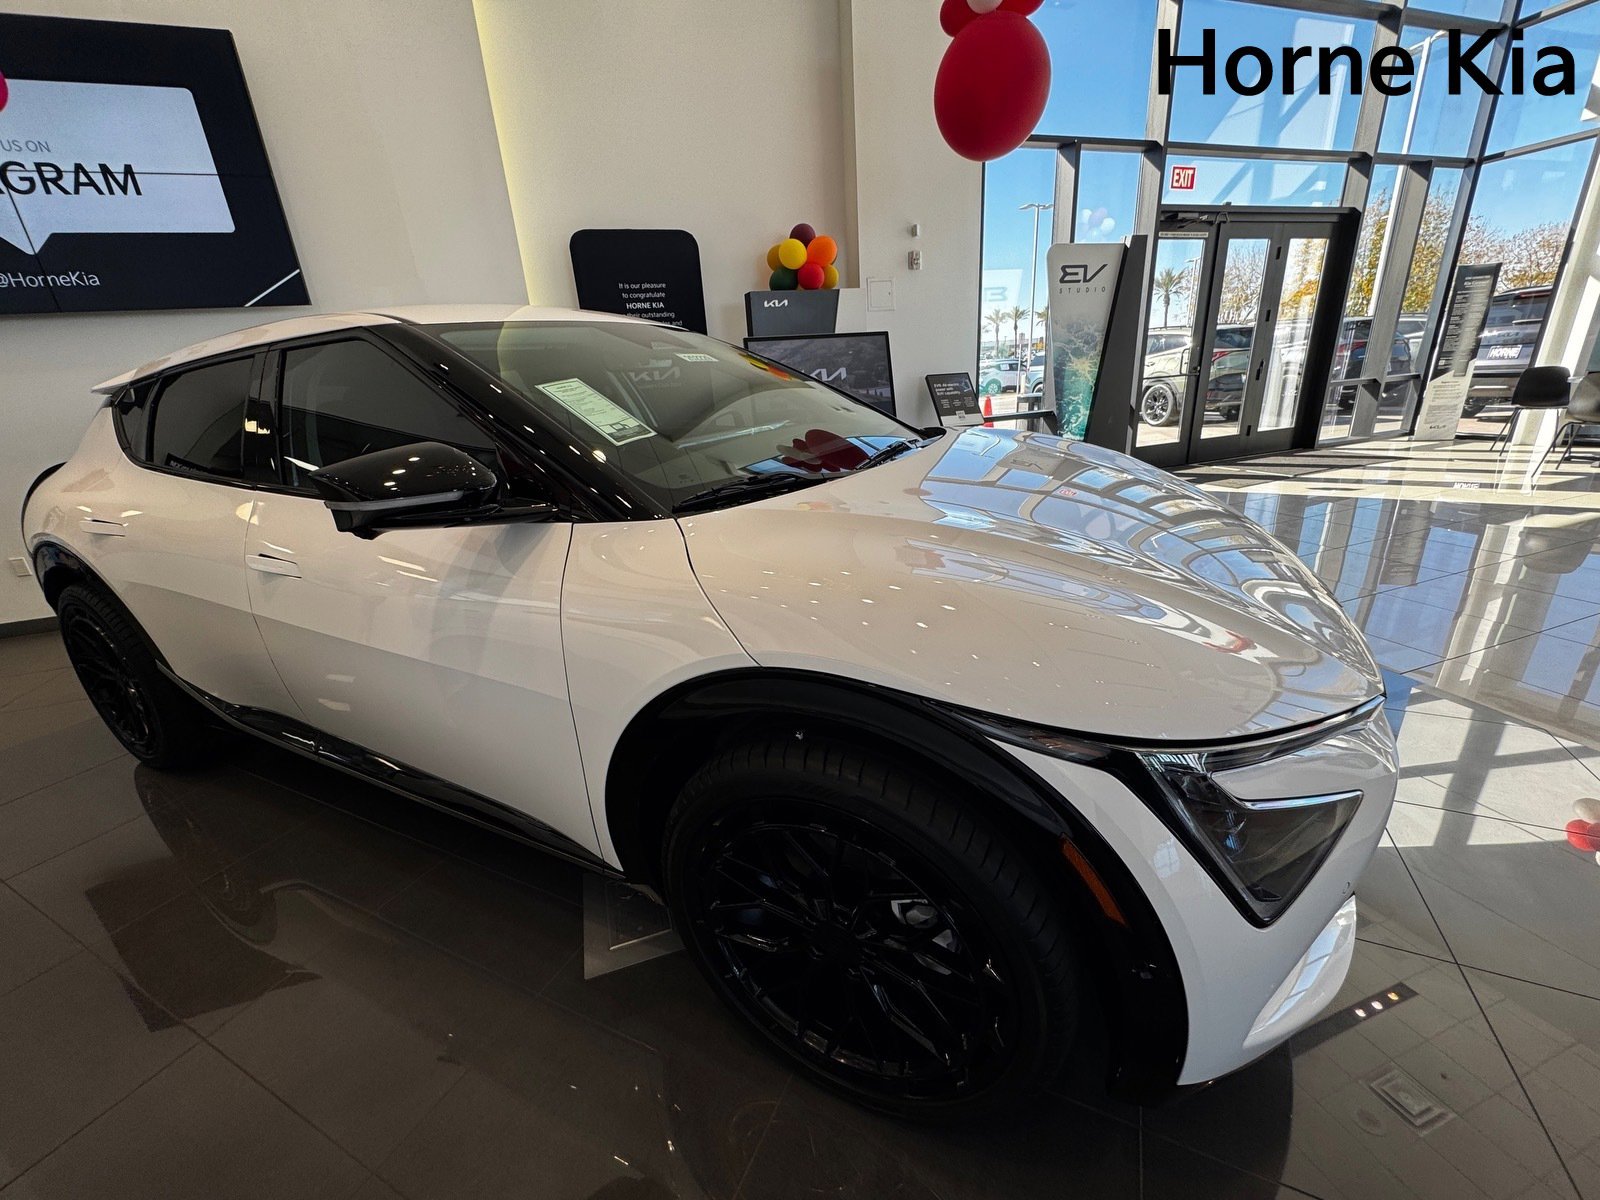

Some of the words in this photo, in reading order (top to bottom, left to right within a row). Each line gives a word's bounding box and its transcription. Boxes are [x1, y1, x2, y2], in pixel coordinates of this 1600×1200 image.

[1, 140, 22, 153] US
[25, 140, 51, 153] ON
[1173, 168, 1194, 189] EXIT
[1059, 264, 1108, 284] EV
[0, 271, 101, 288] @HorneKia
[641, 282, 666, 290] pleasure
[1058, 286, 1107, 294] STUDIO
[629, 291, 666, 300] congratulate
[626, 302, 652, 310] HORNE
[763, 299, 788, 308] KIA
[641, 311, 675, 319] outstanding
[1489, 347, 1519, 359] HORNE
